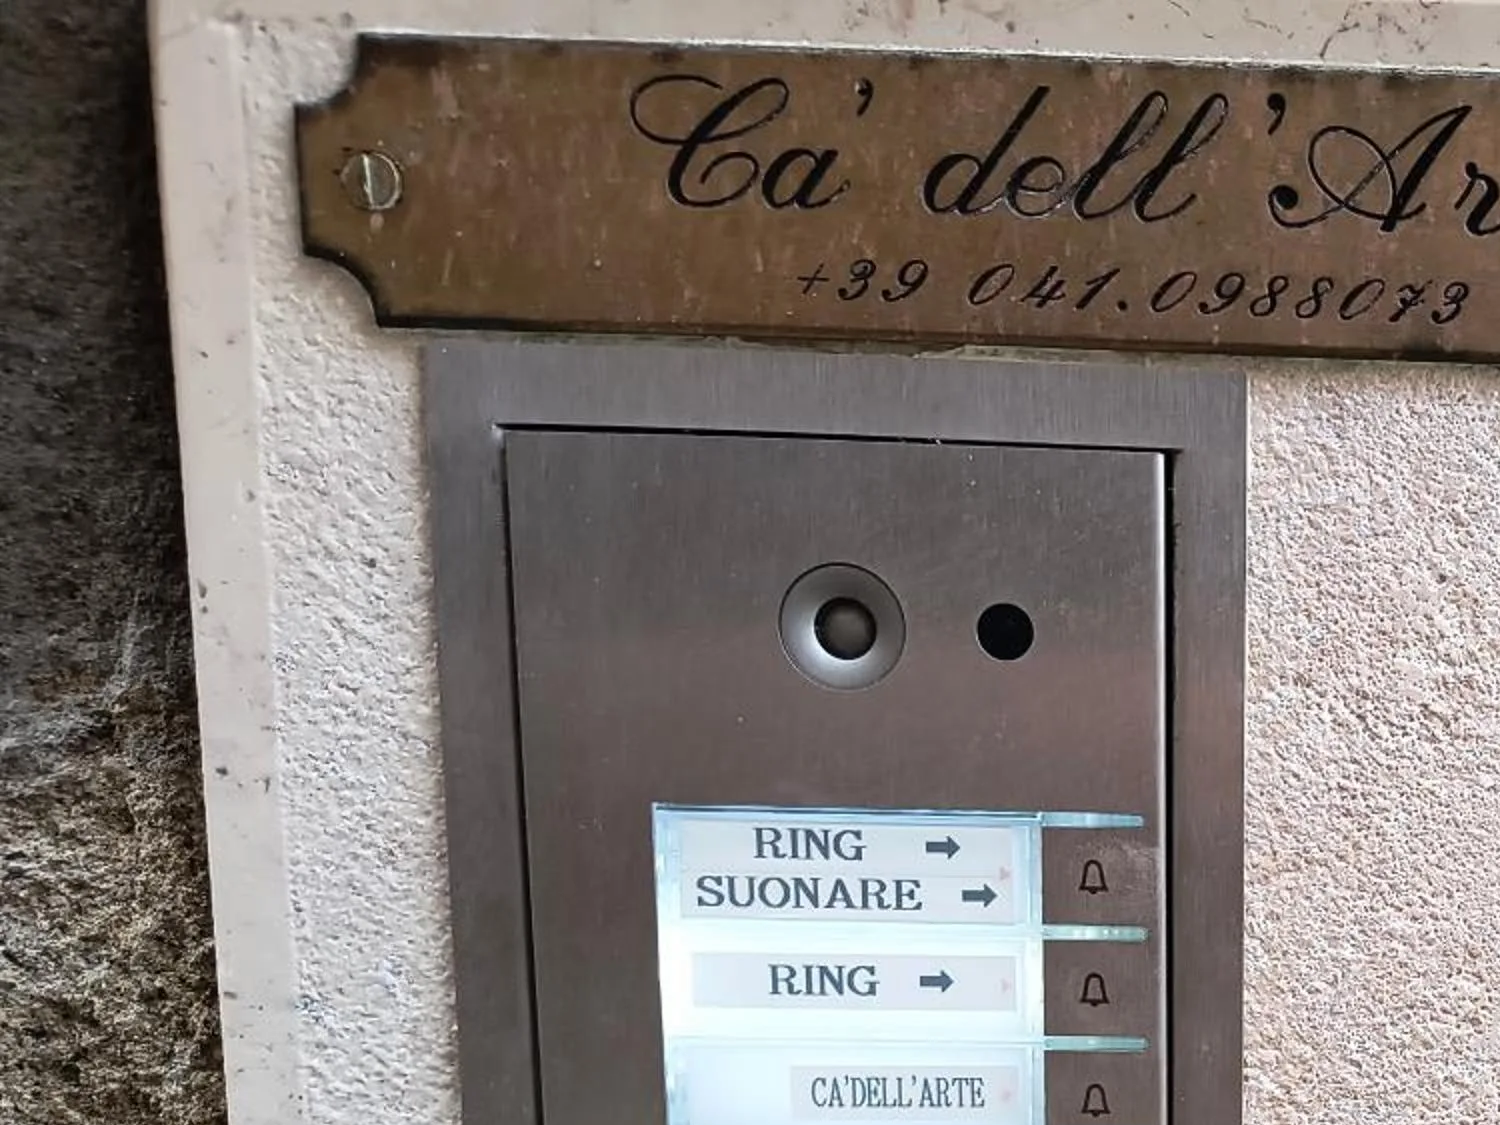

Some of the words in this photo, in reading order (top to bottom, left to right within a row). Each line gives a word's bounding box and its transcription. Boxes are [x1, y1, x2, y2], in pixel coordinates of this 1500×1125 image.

[629, 73, 875, 210] Ca'
[797, 257, 928, 302] +39
[967, 262, 1471, 326] 041.0988073
[753, 827, 865, 862] RING
[697, 876, 923, 911] SUONARE
[769, 964, 879, 997] RING
